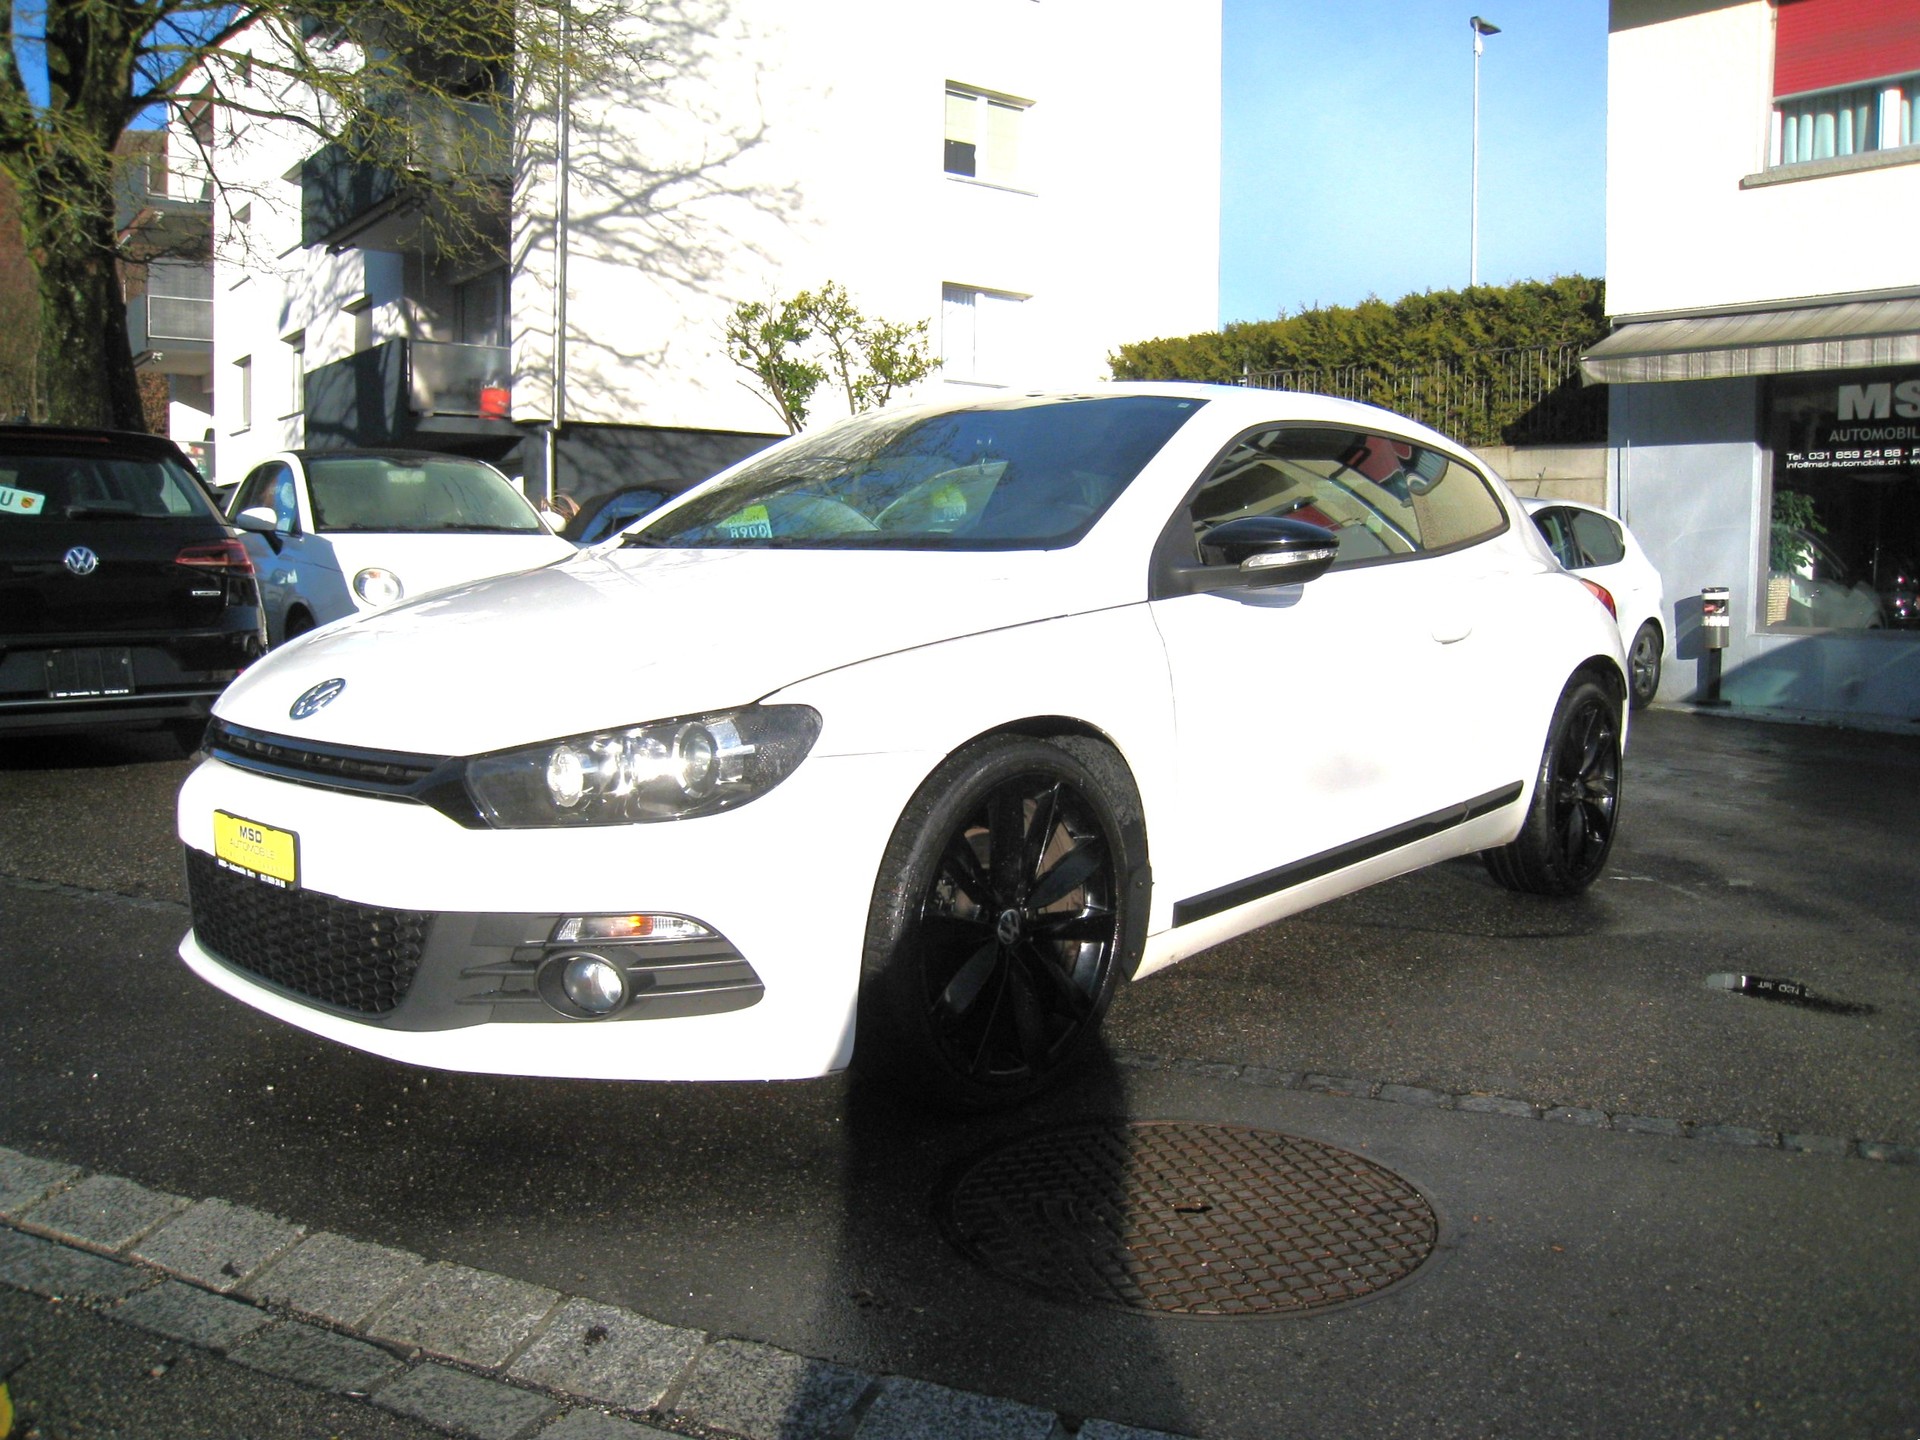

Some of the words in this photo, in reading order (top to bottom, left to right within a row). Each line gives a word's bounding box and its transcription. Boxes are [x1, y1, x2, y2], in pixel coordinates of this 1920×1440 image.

[1837, 380, 1920, 420] MS
[1829, 427, 1920, 442] AUTOMOBIL
[1786, 453, 1805, 461] Tel.
[1808, 452, 1831, 460] 031
[1835, 450, 1860, 459] 859
[1863, 450, 1880, 458] 24
[1884, 449, 1901, 457] 88
[1786, 458, 1900, 469] info@msd-automobile.ch
[239, 825, 262, 844] MSD
